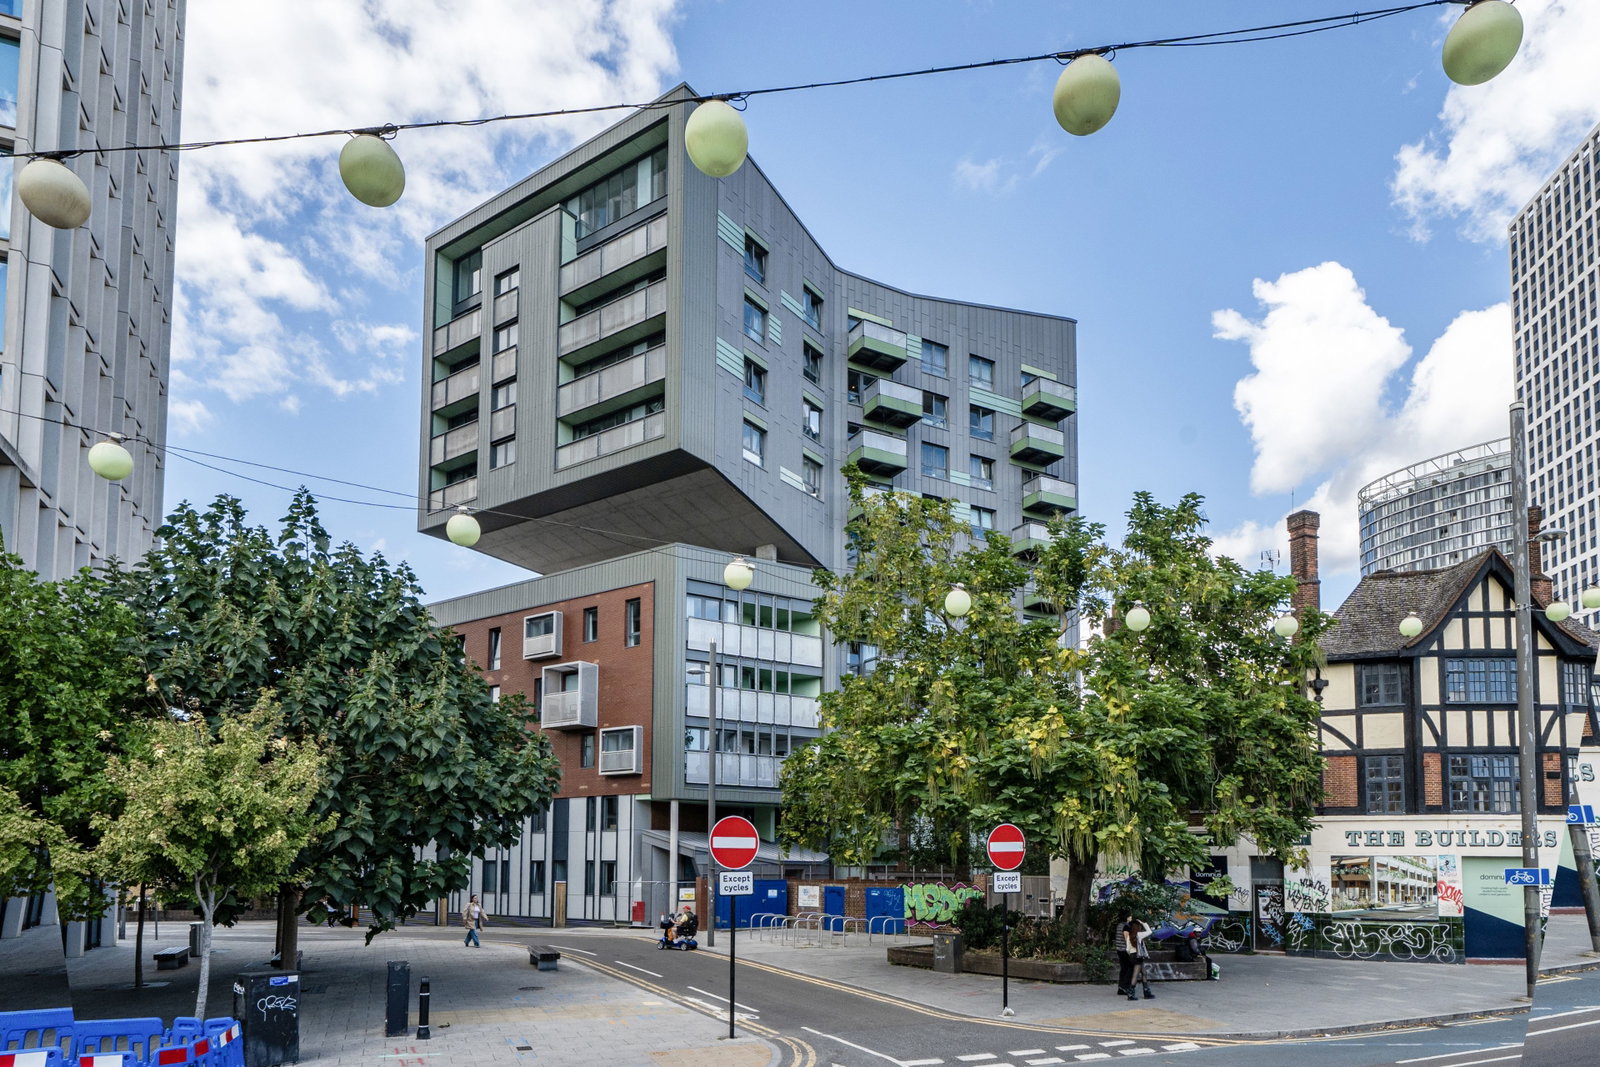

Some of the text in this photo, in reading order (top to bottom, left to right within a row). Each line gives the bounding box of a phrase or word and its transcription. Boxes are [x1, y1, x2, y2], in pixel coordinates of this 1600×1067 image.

[1345, 829, 1558, 848] THE BUILDES
[723, 875, 751, 883] Except
[996, 875, 1018, 883] Except
[1479, 873, 1505, 881] dominu
[724, 884, 749, 893] cycles
[997, 883, 1017, 891] cycles
